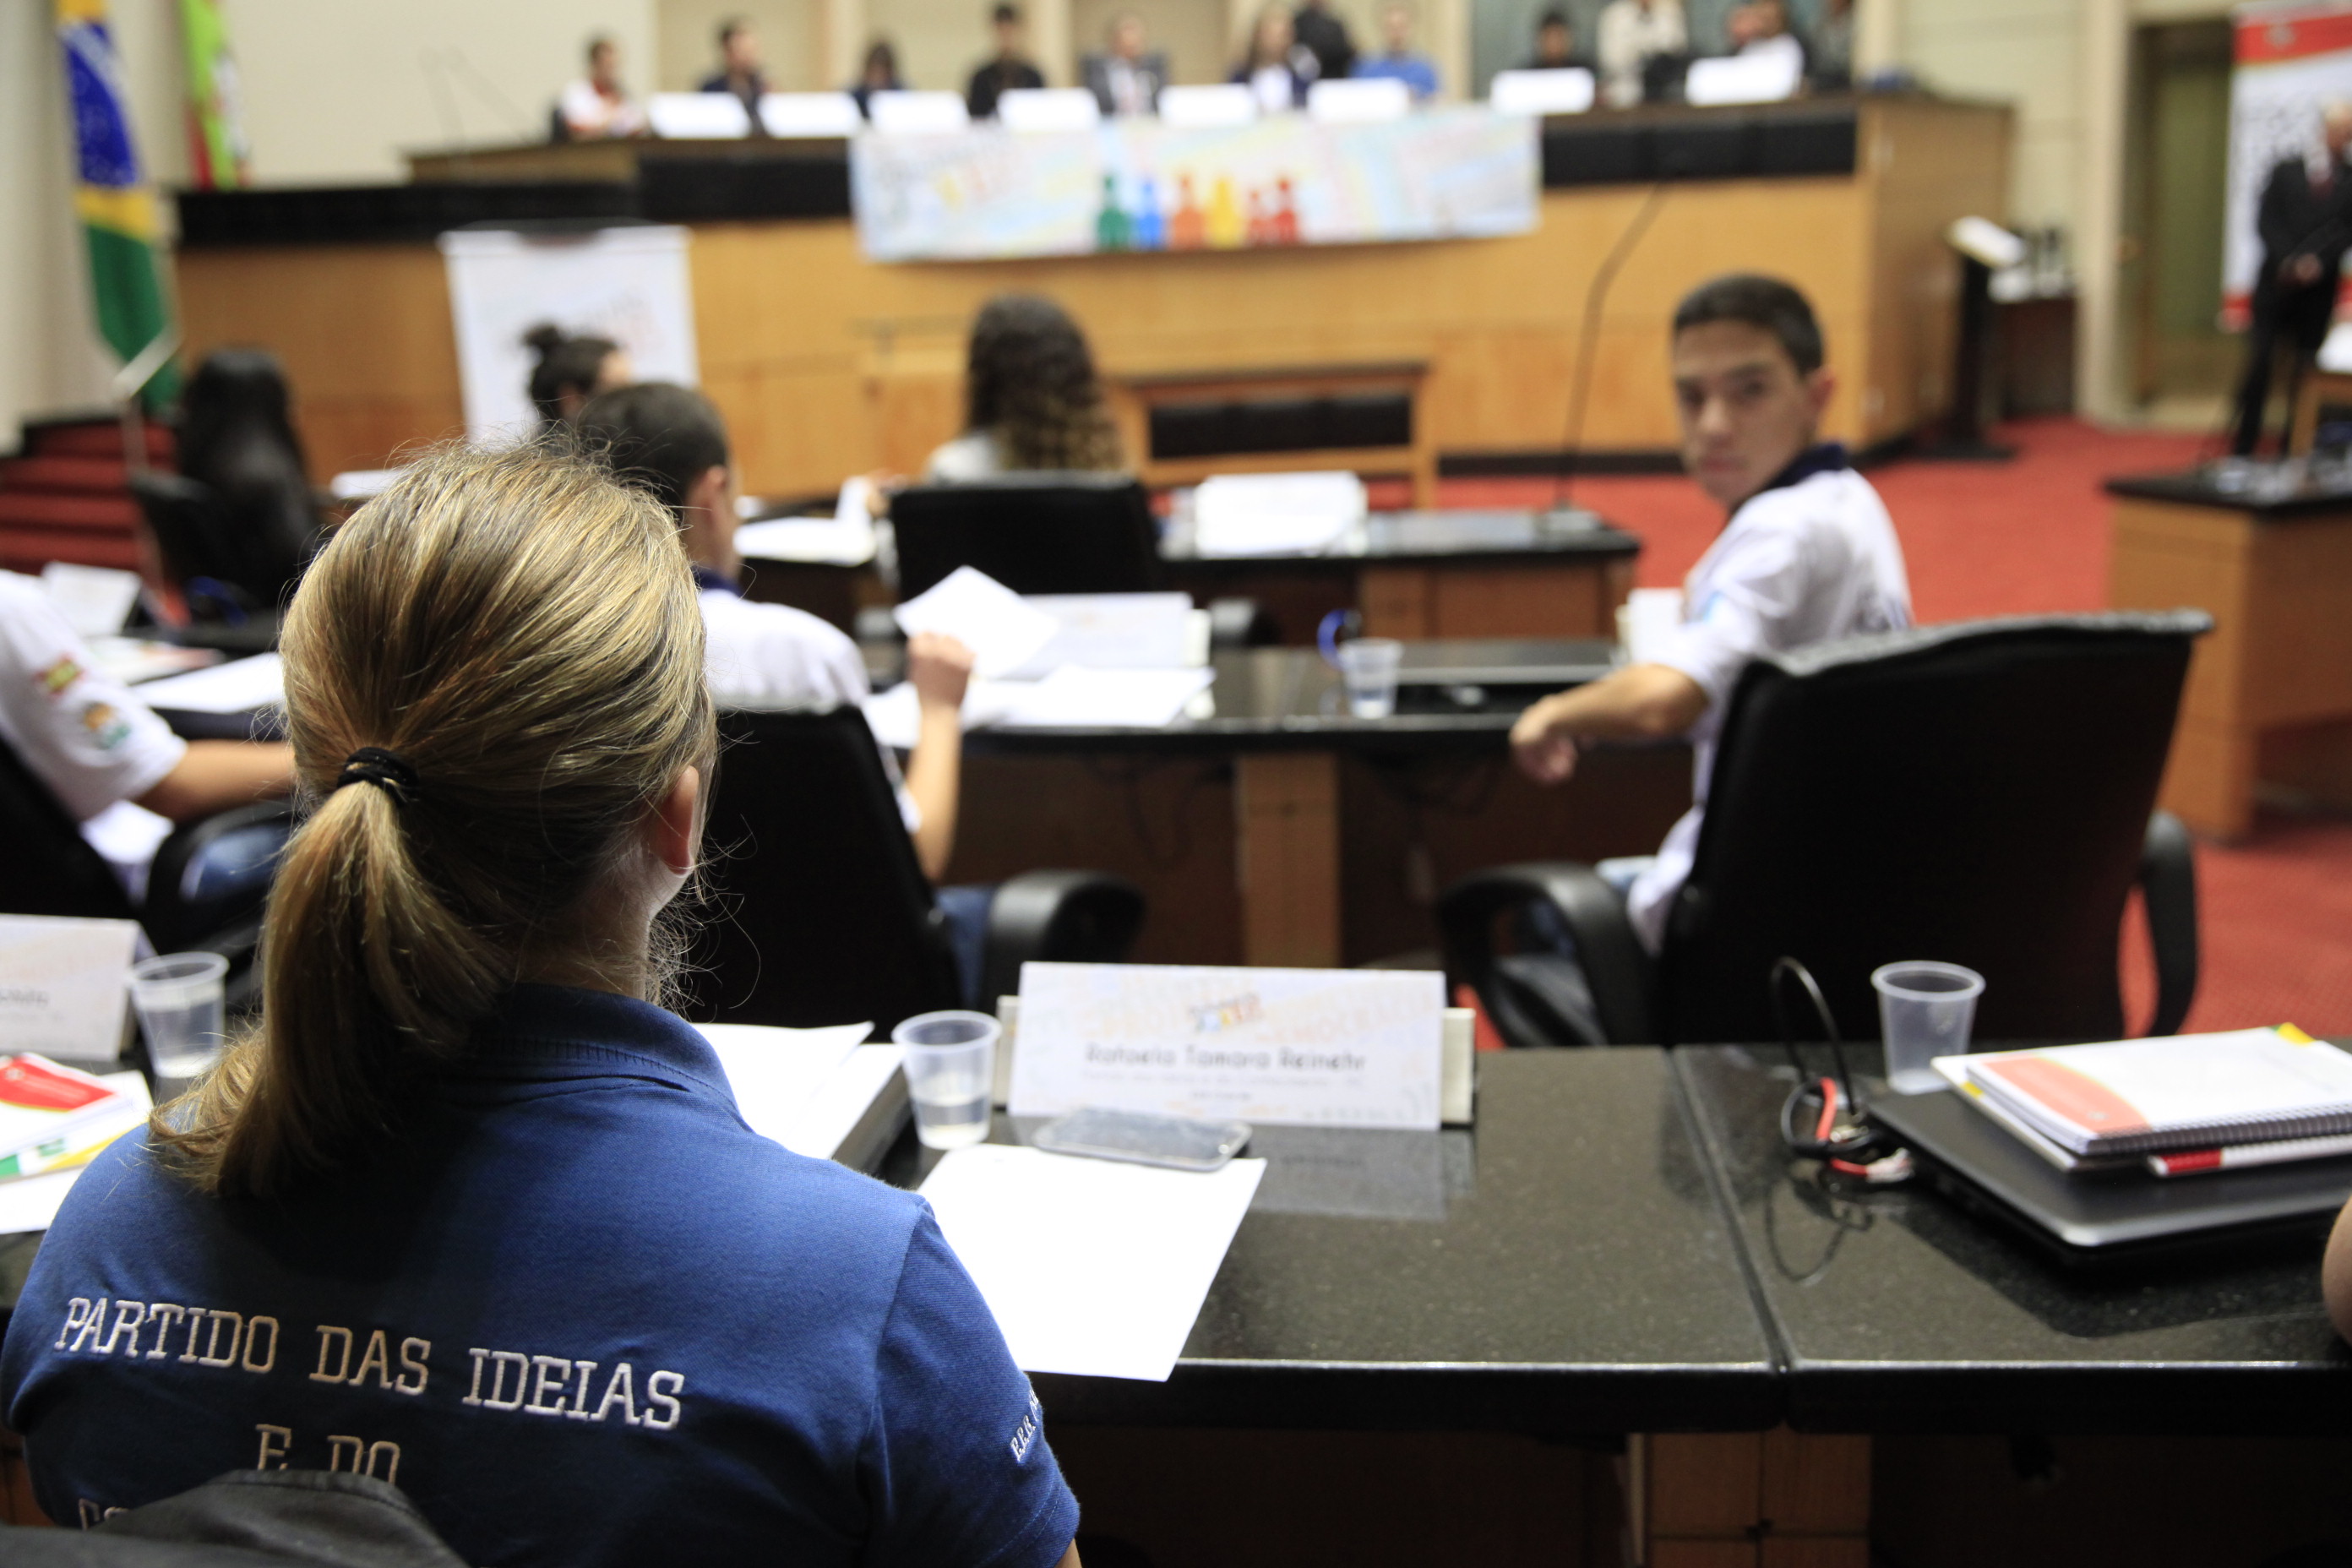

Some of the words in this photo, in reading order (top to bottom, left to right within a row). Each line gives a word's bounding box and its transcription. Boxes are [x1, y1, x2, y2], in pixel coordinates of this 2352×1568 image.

[54, 1298, 280, 1374] PARTIDO
[309, 1324, 432, 1396] DAS
[461, 1347, 685, 1431] IDEIAS
[255, 1424, 292, 1471] E
[327, 1435, 400, 1485] DO
